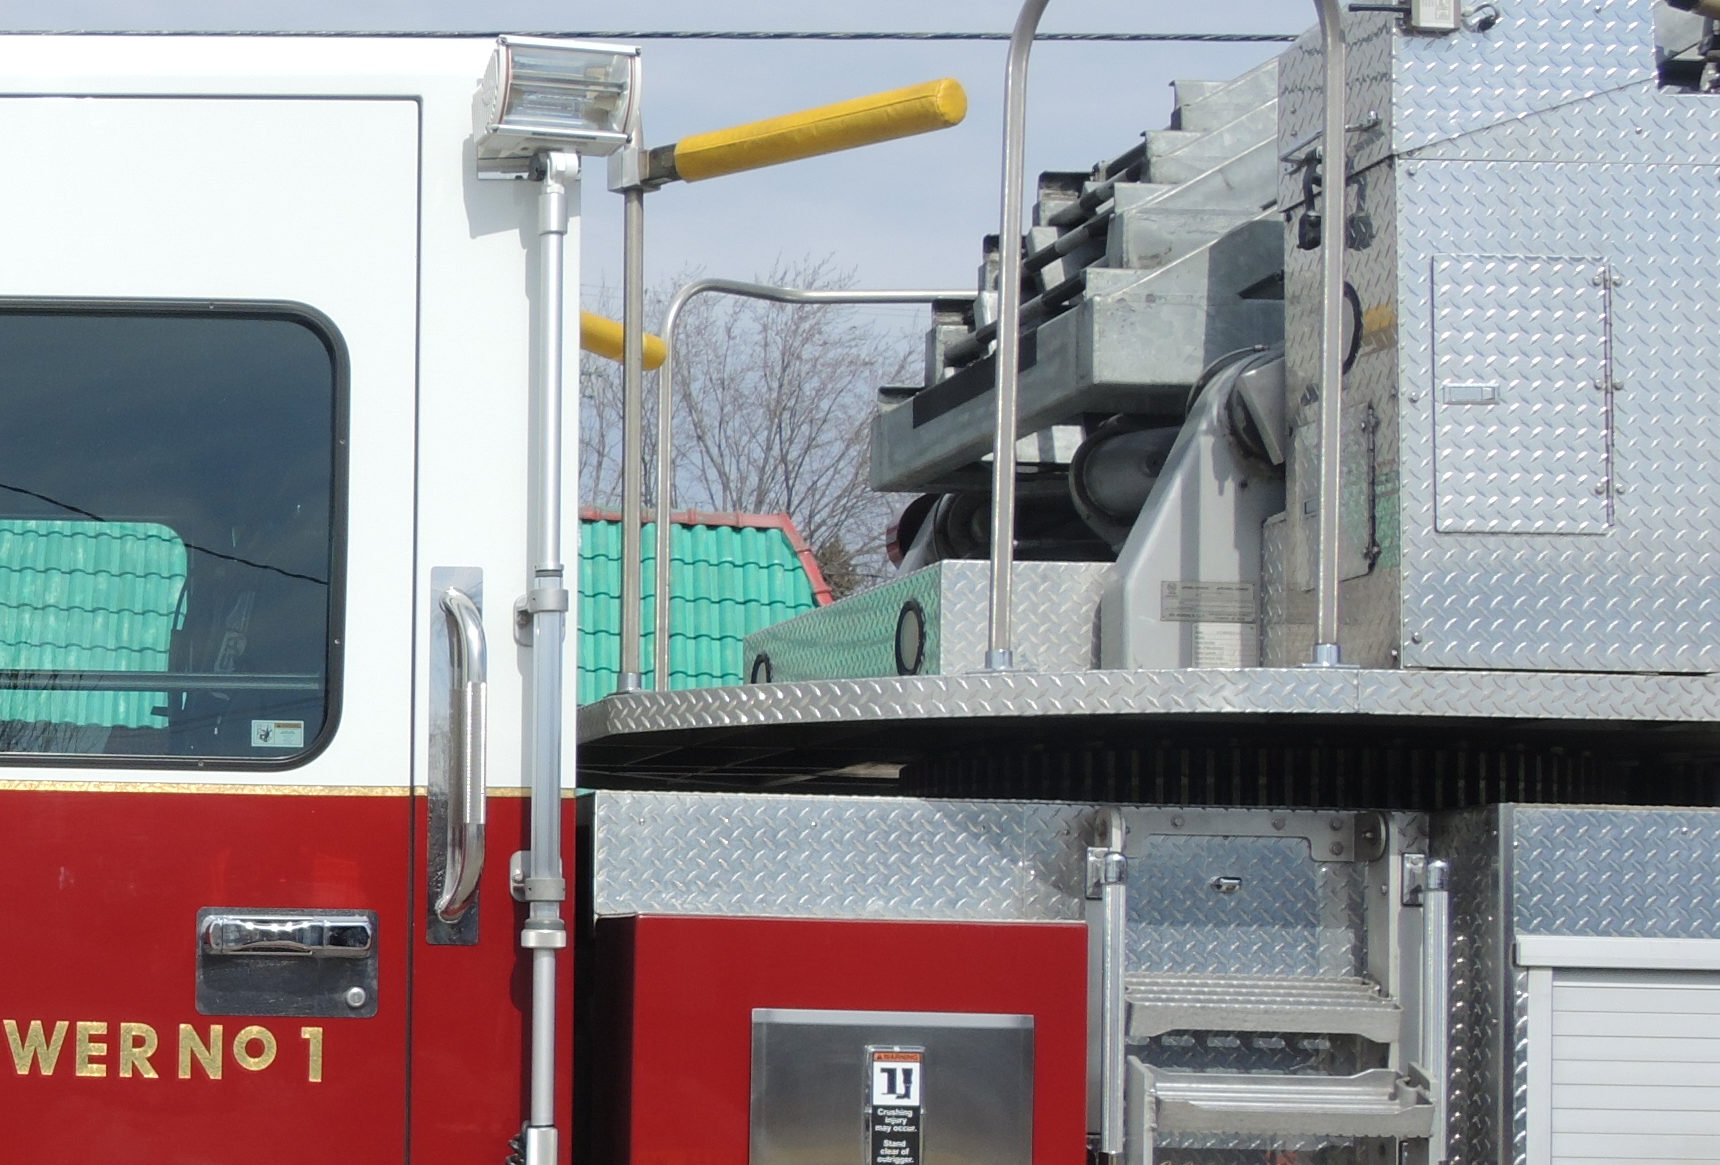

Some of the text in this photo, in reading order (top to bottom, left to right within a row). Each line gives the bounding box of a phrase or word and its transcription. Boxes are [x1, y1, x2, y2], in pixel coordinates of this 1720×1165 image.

[300, 1026, 324, 1083] 1
[877, 1108, 913, 1118] Crushing
[875, 1125, 891, 1133] may
[883, 1139, 906, 1148] Stand
[880, 1147, 910, 1155] clear of
